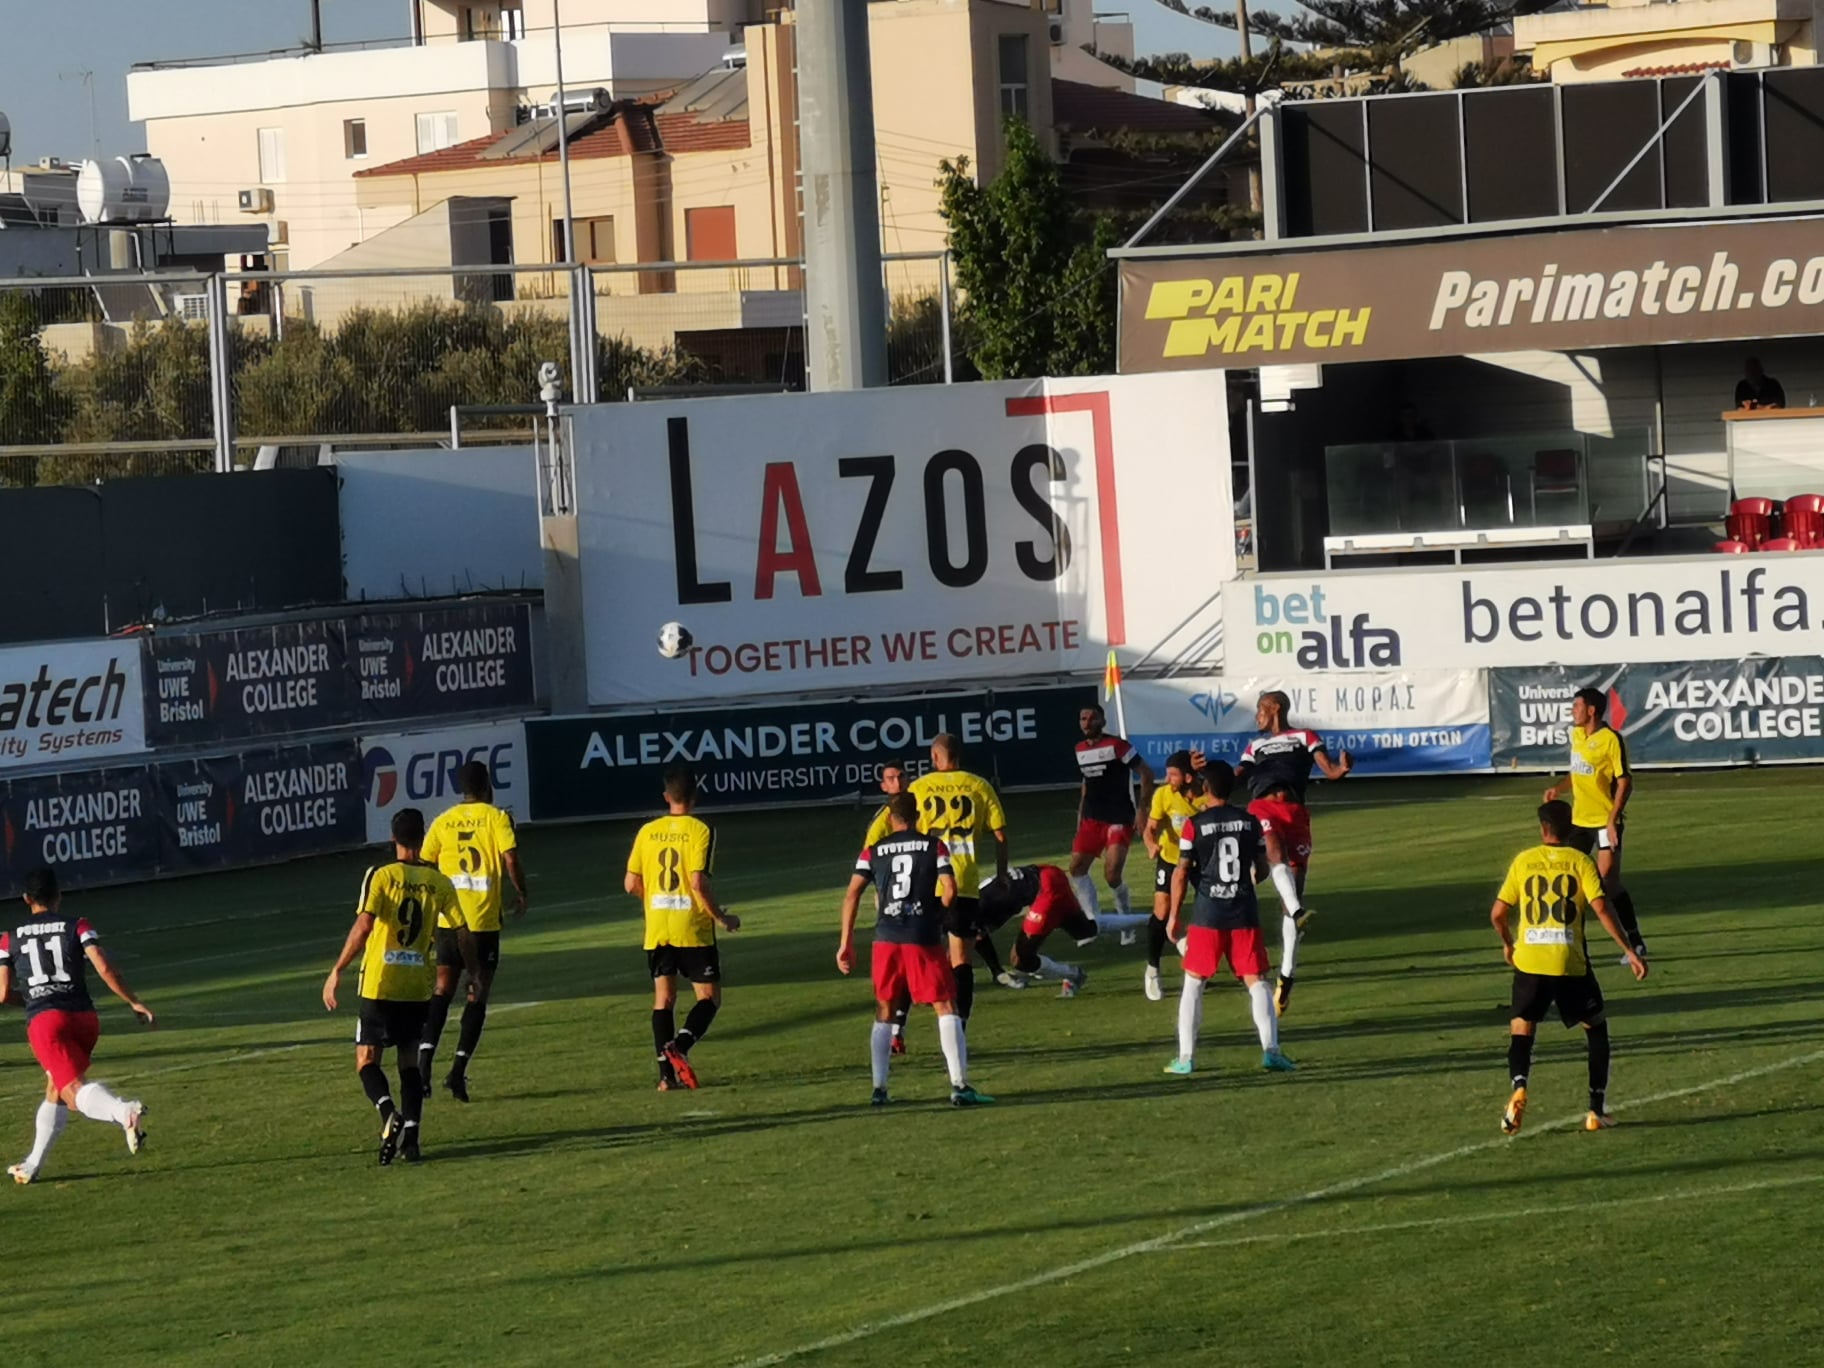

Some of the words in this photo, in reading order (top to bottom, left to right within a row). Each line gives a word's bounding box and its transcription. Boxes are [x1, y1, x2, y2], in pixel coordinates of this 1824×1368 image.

[1145, 272, 1300, 320] PARI
[1162, 307, 1371, 357] MATCH
[666, 416, 1072, 605] LAZOS
[1254, 584, 1327, 626] bet
[422, 626, 516, 662] ALEXANDER
[687, 634, 872, 677] TOGETHER
[881, 630, 938, 663] WE
[946, 619, 1080, 658] CREATE
[1256, 630, 1293, 654] on
[1297, 613, 1401, 670] alfa
[157, 657, 196, 674] University
[226, 643, 330, 682] ALEXANDER
[360, 656, 388, 676] UWE
[435, 659, 506, 692] COLLEGE
[158, 676, 190, 699] UWE
[242, 678, 318, 714] COLLEGE
[361, 677, 401, 700] Bristol
[160, 699, 204, 723] Bristol
[1519, 701, 1575, 724] UWE
[1673, 708, 1822, 742] COLLEGE
[0, 736, 28, 758] ity
[38, 729, 123, 754] Systems
[580, 721, 841, 769] ALEXANDER
[850, 707, 1038, 751] COLLEGE
[244, 762, 348, 804] ALEXANDER
[714, 765, 840, 792] UNIVERSITY
[24, 788, 142, 831] ALEXANDER
[177, 800, 207, 823] UWE
[260, 797, 337, 835] COLLEGE
[923, 795, 975, 838] 22
[42, 824, 128, 864] COLLEGE
[178, 821, 221, 847] Bristol
[457, 830, 482, 874] 5
[658, 846, 680, 893] 8
[891, 854, 913, 900] 3
[1218, 836, 1241, 883] 8
[1524, 873, 1579, 926] 88
[397, 896, 423, 947] 9
[20, 935, 71, 986] 11
